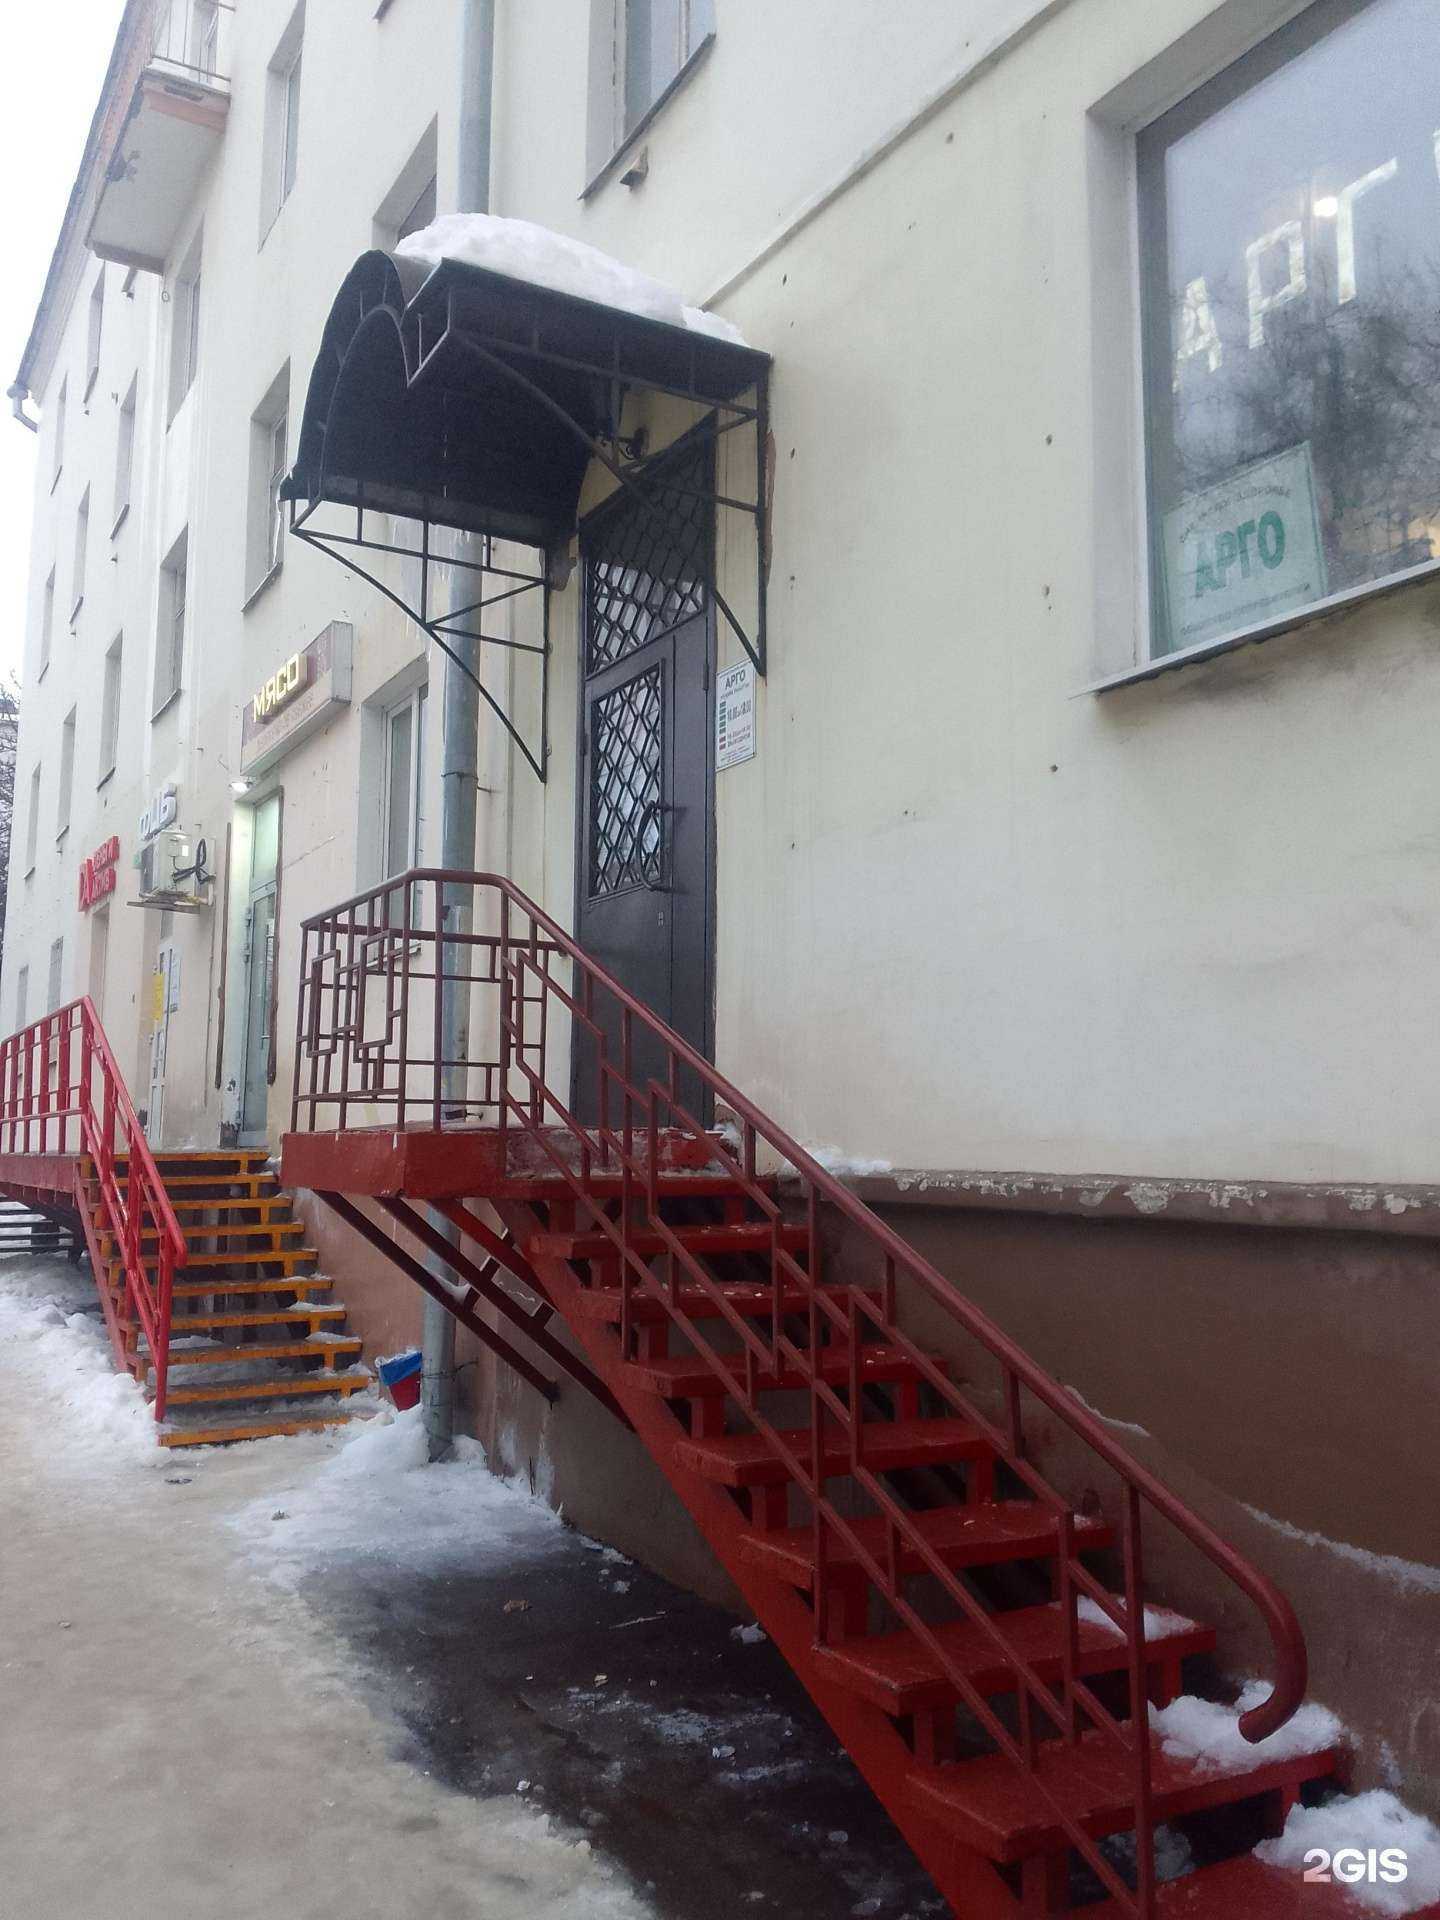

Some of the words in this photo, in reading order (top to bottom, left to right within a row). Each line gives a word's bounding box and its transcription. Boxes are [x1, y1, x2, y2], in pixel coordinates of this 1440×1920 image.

[1172, 127, 1440, 393] АРГ
[1195, 510, 1286, 595] АРГО
[253, 652, 300, 723] МЯСО
[724, 668, 746, 690] АРГО
